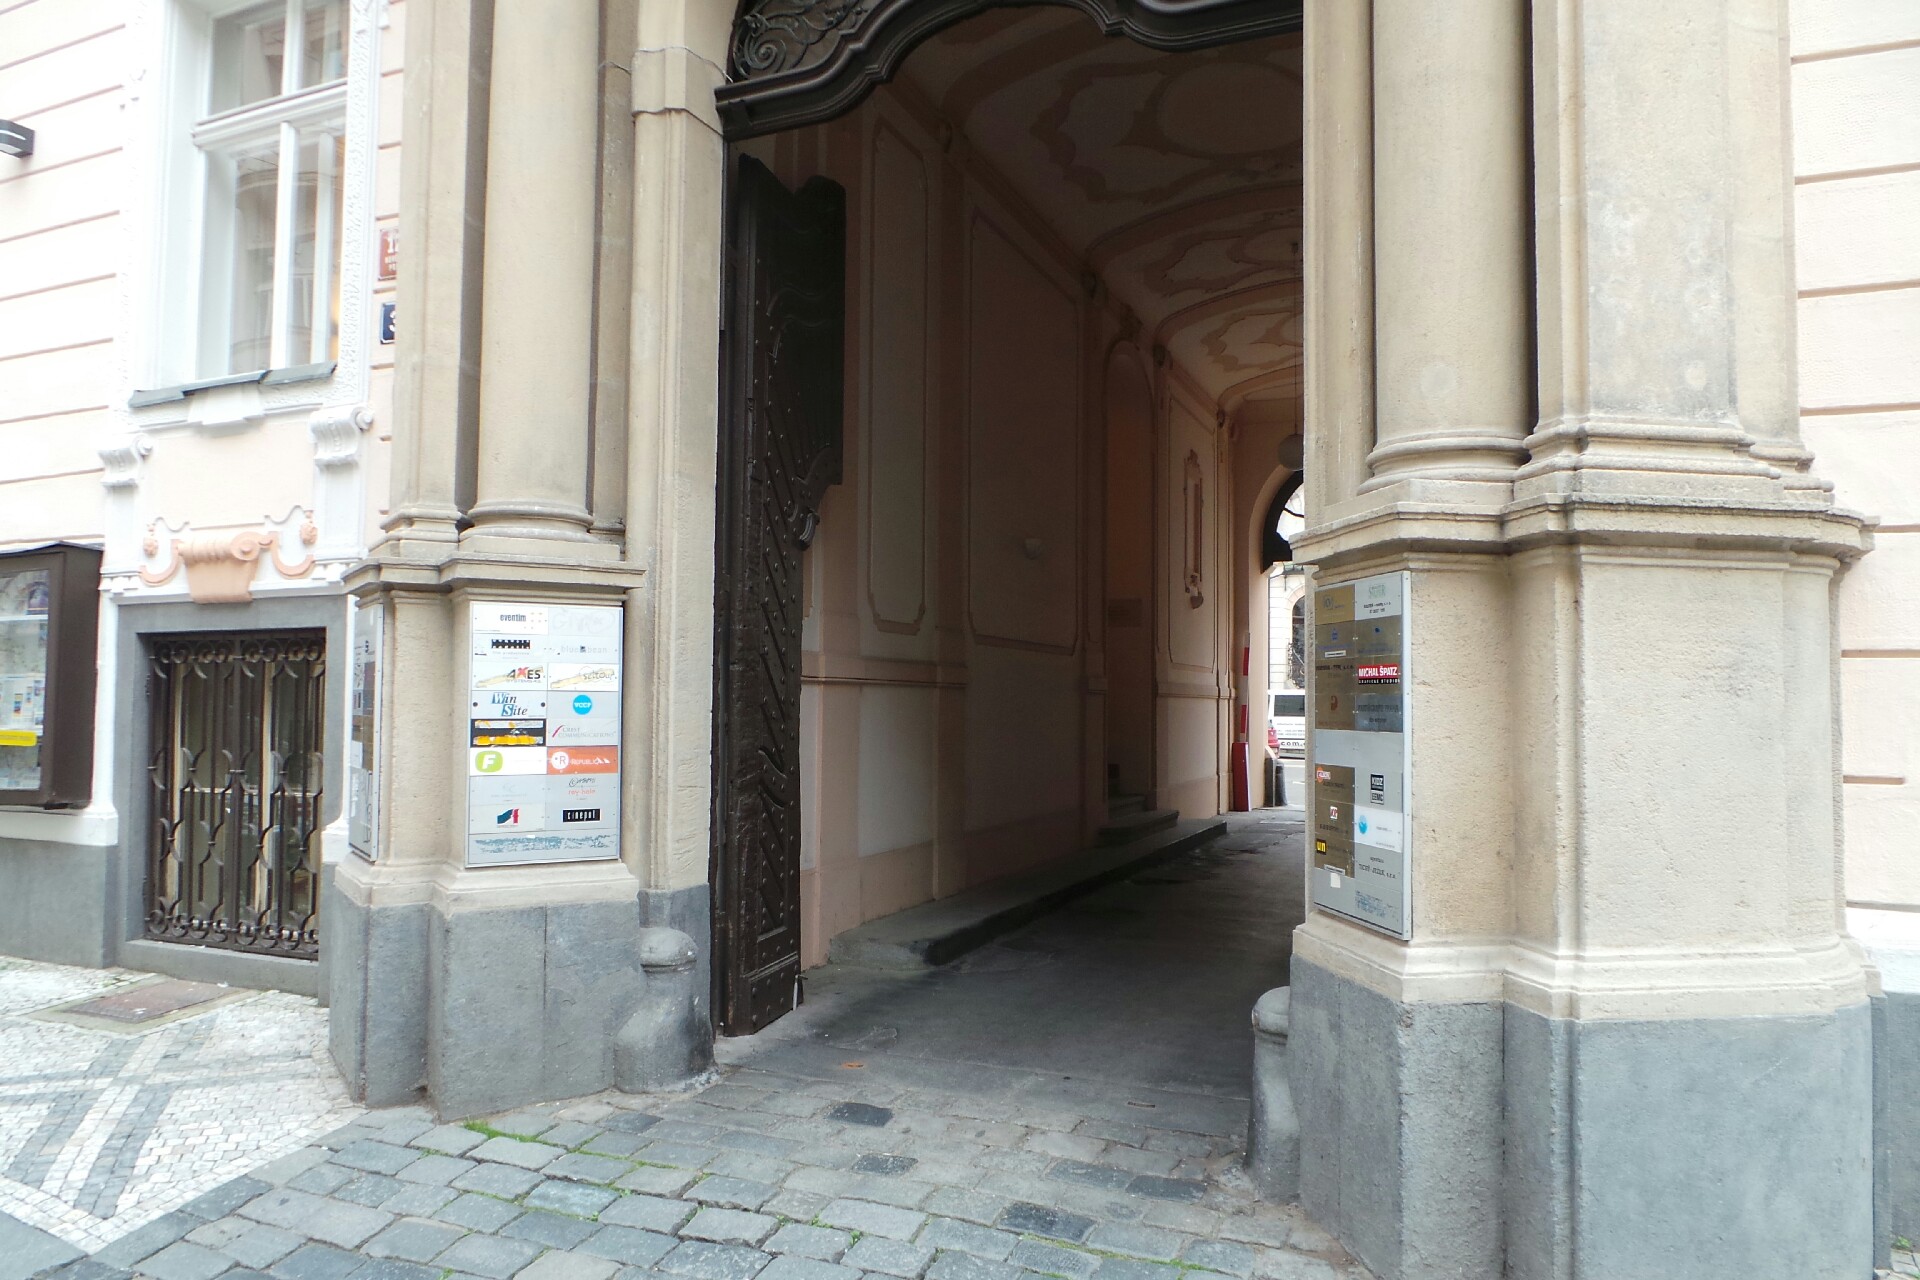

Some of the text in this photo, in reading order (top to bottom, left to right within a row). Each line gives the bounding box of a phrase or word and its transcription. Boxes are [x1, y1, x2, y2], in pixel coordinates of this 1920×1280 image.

[499, 613, 527, 622] eventim
[506, 666, 541, 680] AXES
[1358, 667, 1379, 677] MICHAL
[1379, 665, 1398, 677] ŠPATZ
[491, 692, 517, 705] Win
[501, 704, 528, 717] Site
[481, 754, 496, 770] F
